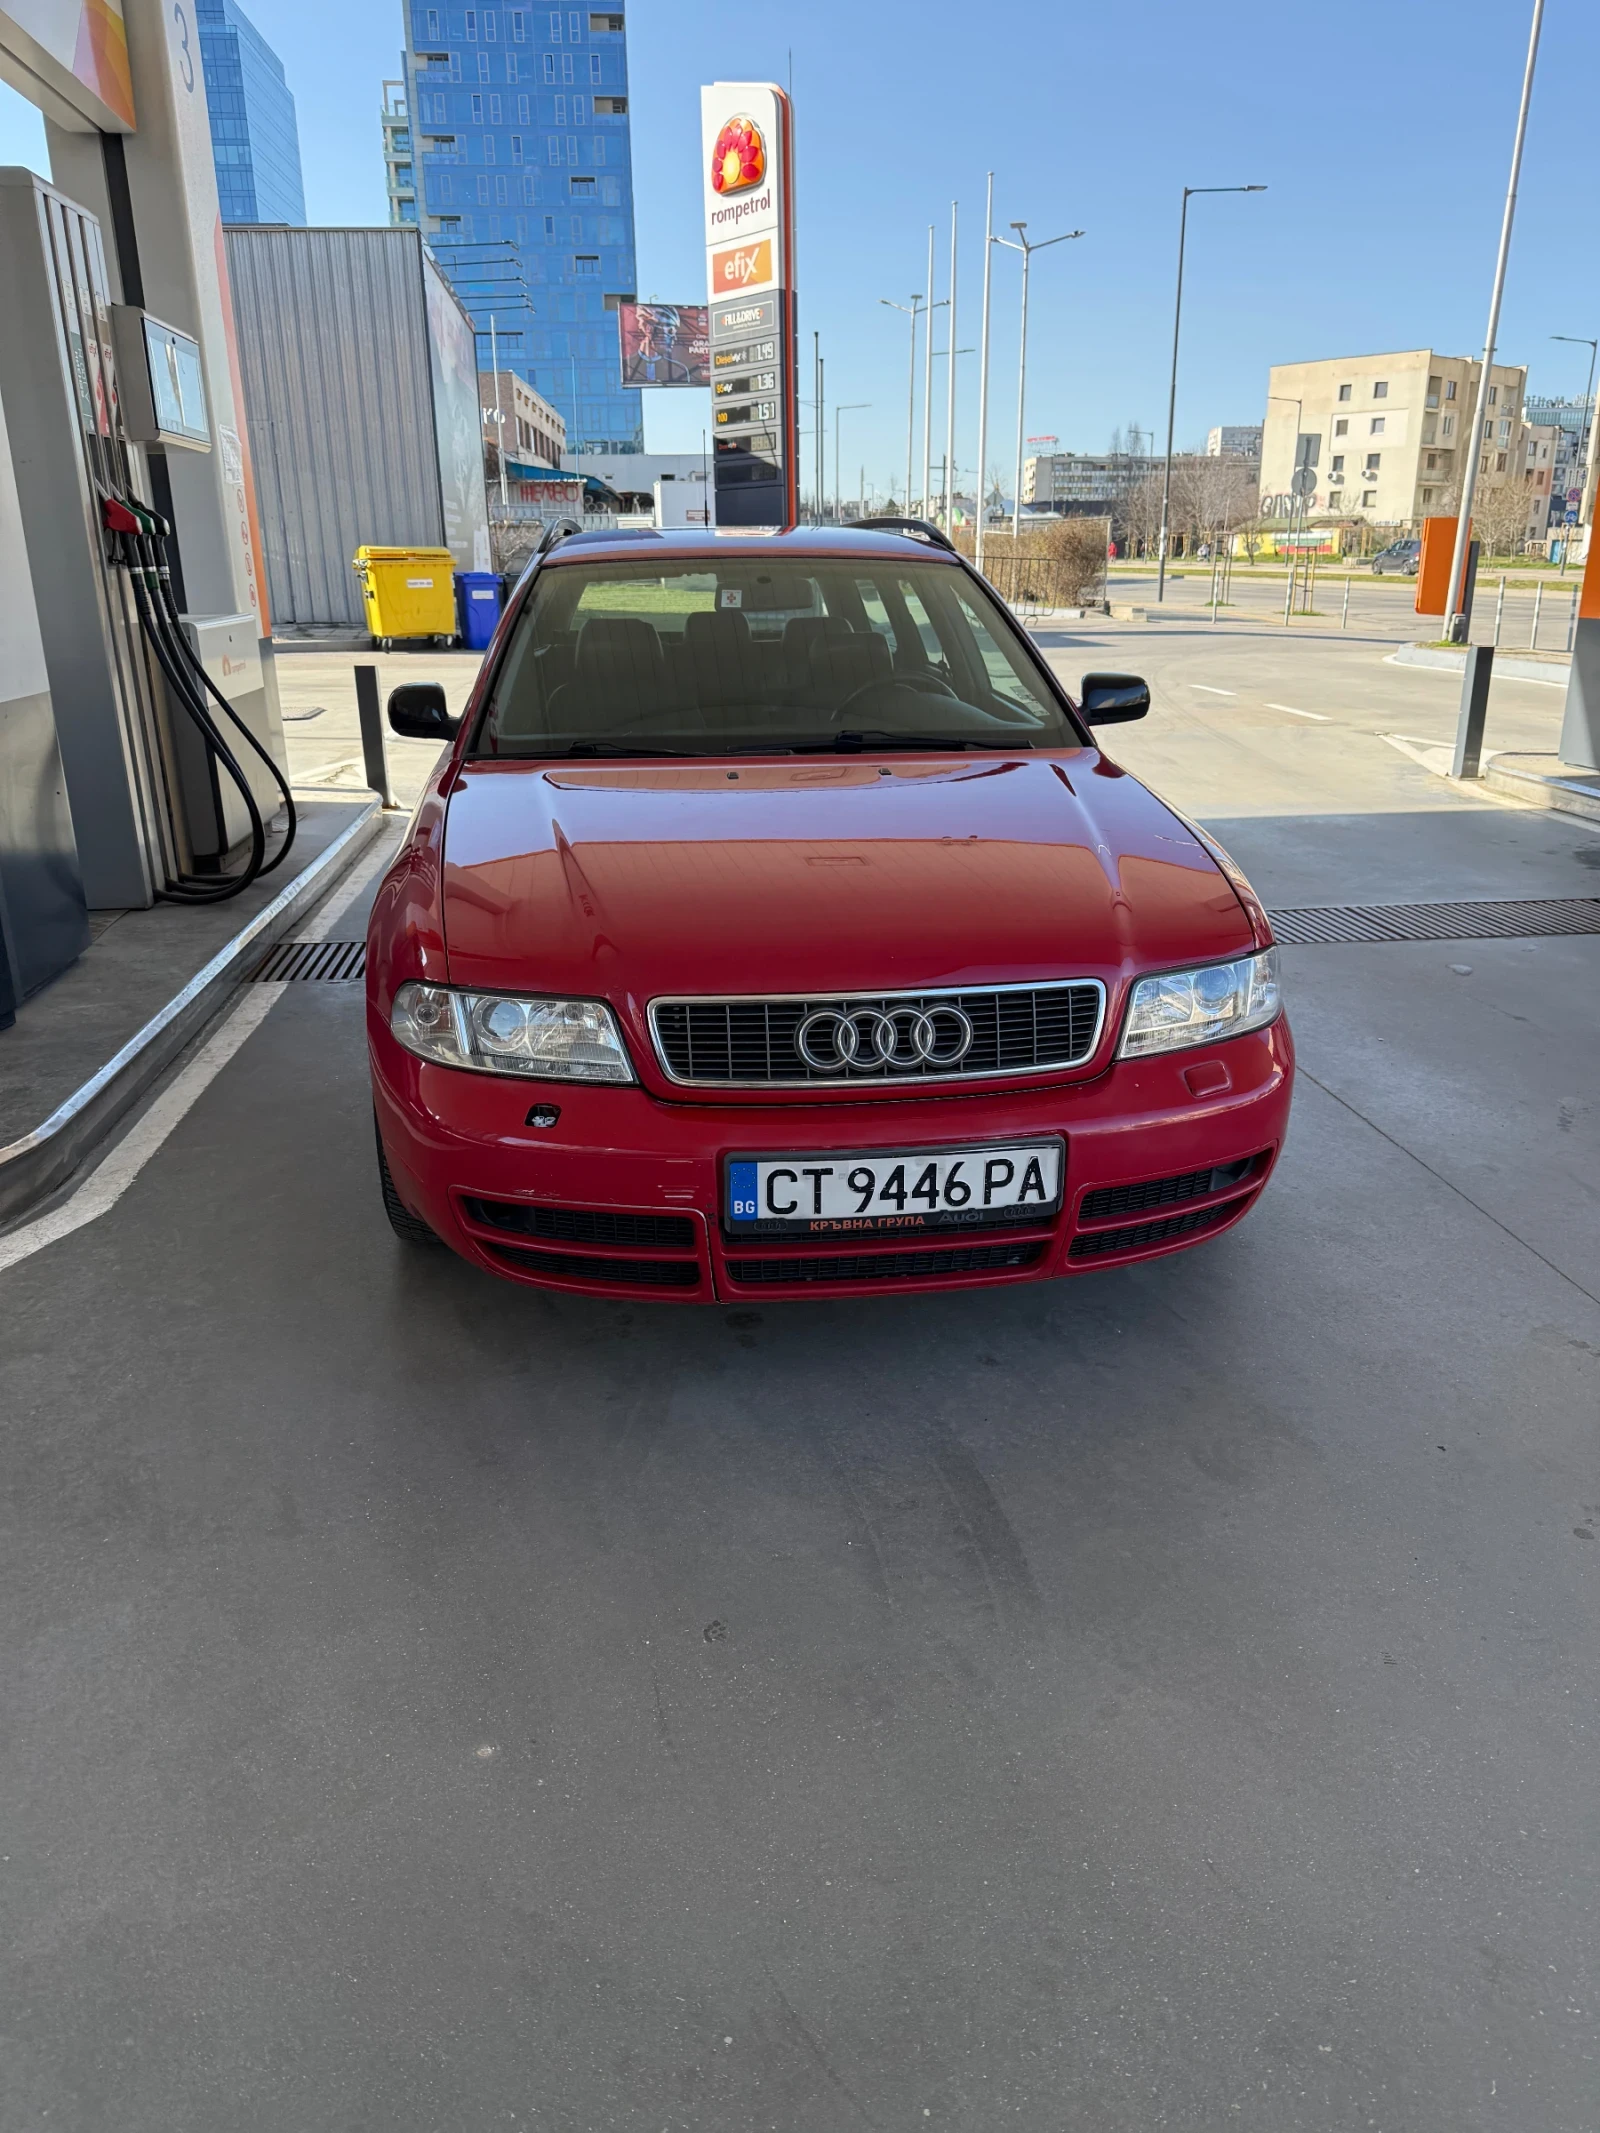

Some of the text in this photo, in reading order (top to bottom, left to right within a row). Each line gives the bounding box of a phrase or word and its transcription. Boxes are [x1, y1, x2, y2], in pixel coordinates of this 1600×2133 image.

[174, 3, 195, 94] 3
[711, 188, 771, 225] rompetrol
[724, 247, 760, 284] efix
[757, 341, 774, 361] 1.49
[717, 402, 775, 423] 100 1.51
[766, 1155, 1047, 1215] CT 9446 PA
[733, 1200, 756, 1214] BG
[938, 1209, 984, 1223] Audi
[810, 1215, 926, 1231] КРЪВНА ГРУПА
